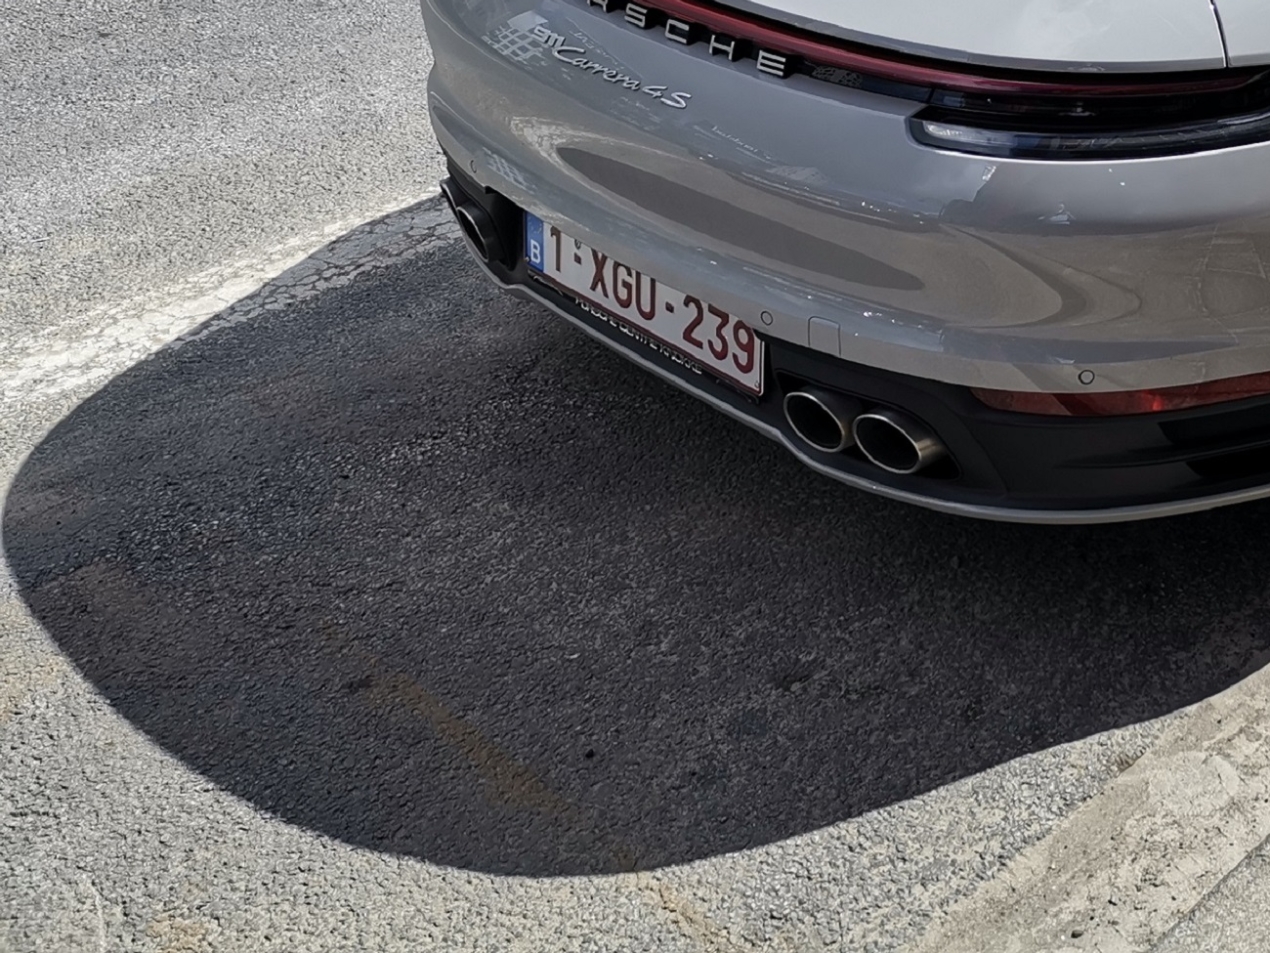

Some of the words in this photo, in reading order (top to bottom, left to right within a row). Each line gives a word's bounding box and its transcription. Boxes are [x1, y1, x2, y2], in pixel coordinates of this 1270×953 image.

[533, 25, 566, 48] 911
[552, 46, 641, 92] Carrera
[530, 239, 541, 264] B
[550, 225, 755, 374] 1-XGU-239
